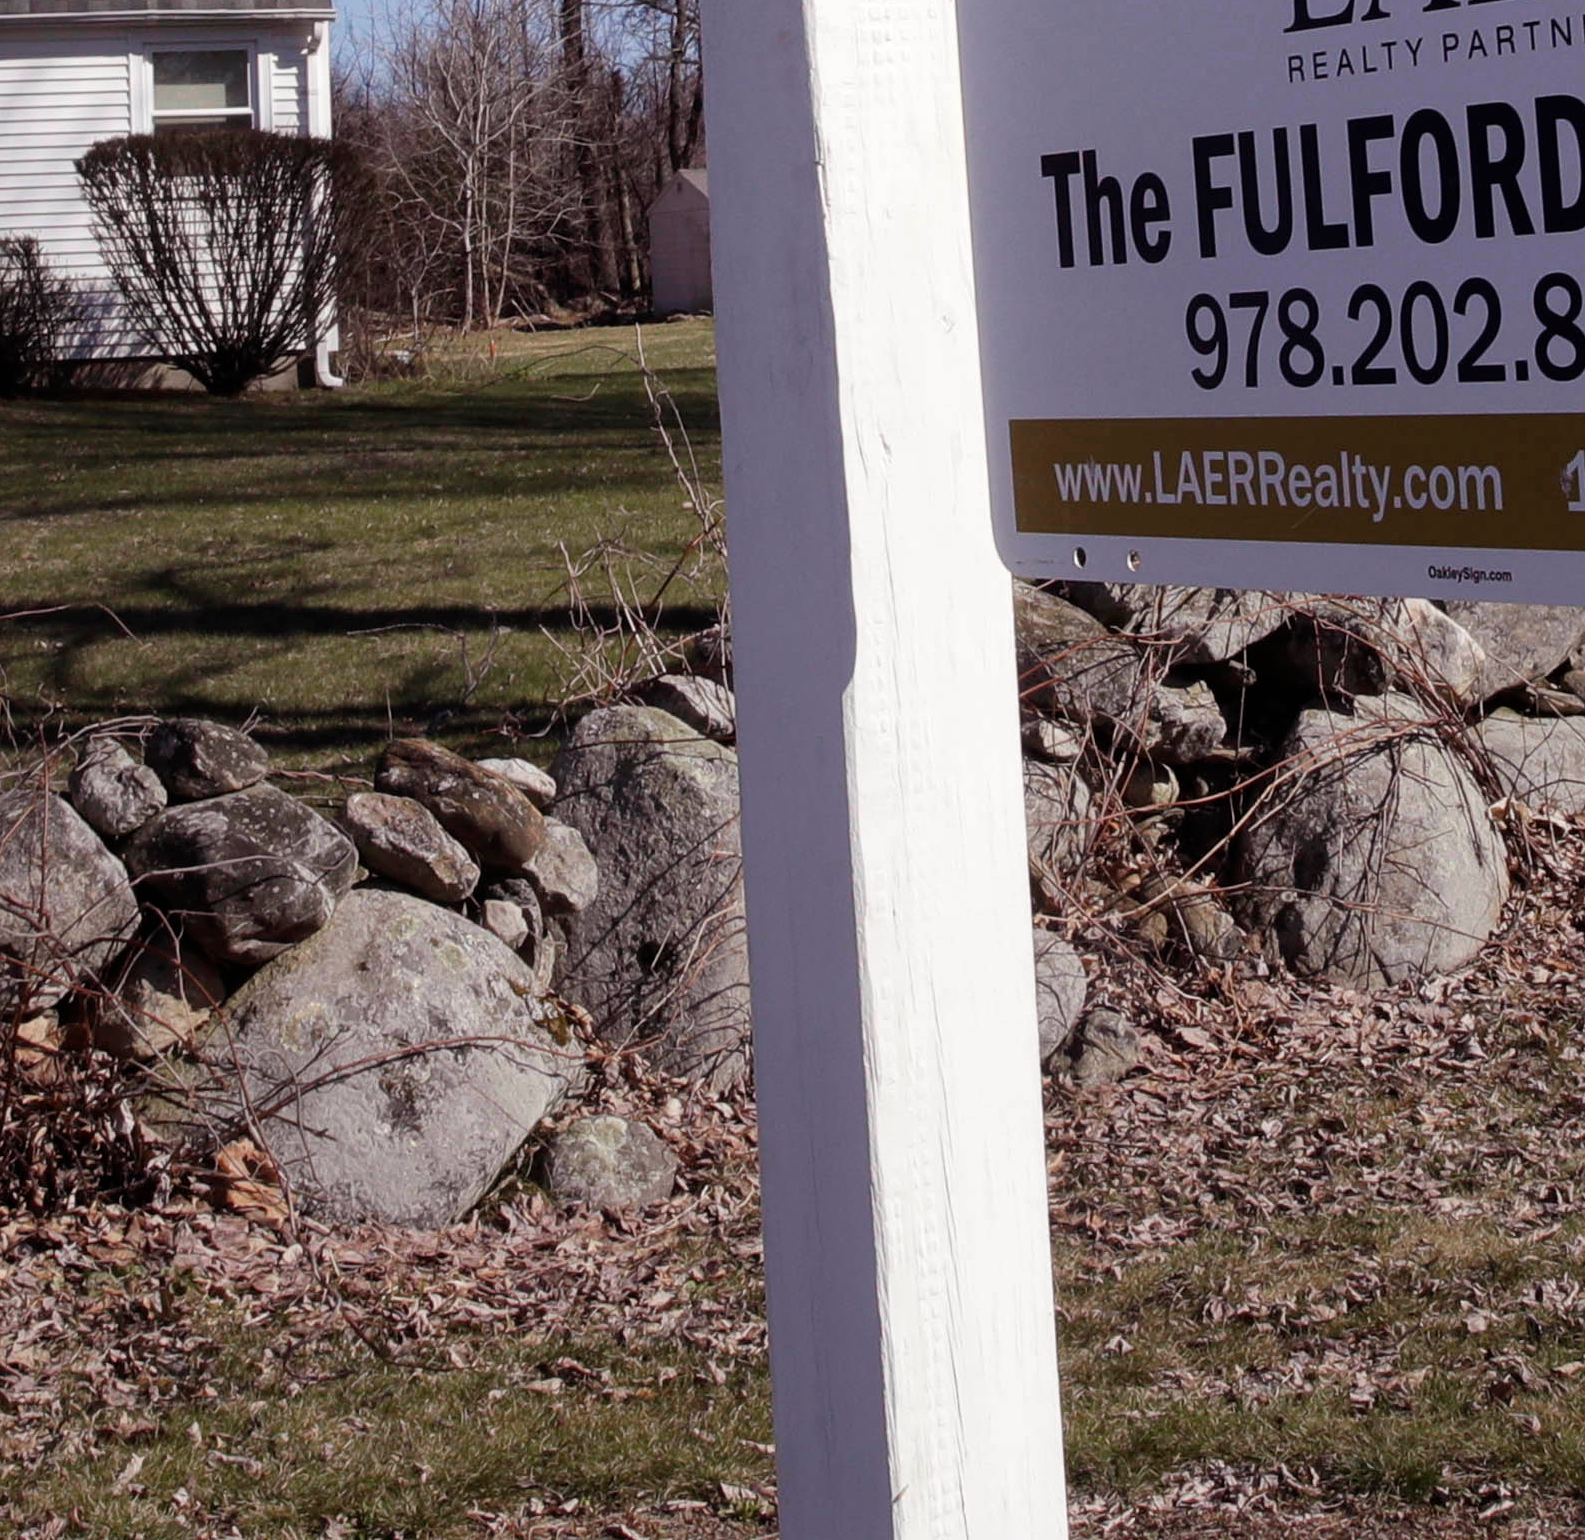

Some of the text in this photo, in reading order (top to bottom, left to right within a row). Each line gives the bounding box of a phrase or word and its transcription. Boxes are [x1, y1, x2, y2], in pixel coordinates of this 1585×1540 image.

[1287, 37, 1423, 84] REALTY
[1040, 149, 1172, 269] The
[1053, 450, 1503, 523] www.LAERRealty.com
[1427, 565, 1513, 585] OakleySign.com
